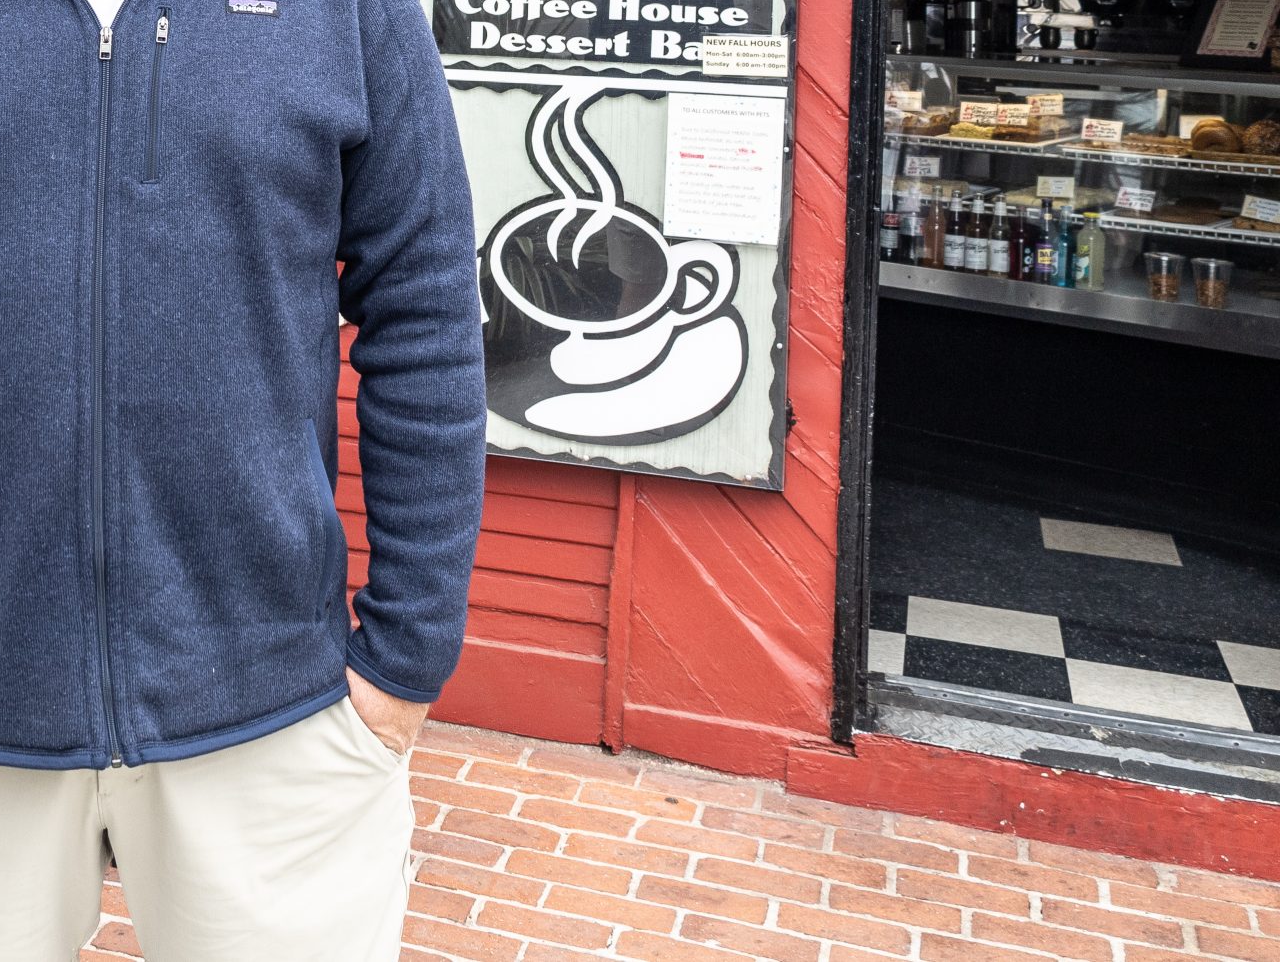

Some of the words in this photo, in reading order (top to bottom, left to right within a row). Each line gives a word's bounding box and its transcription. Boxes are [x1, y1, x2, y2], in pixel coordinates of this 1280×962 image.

[469, 21, 630, 57] Dessert
[650, 29, 703, 60] Ba
[728, 39, 748, 47] FALL
[750, 40, 782, 48] HOURS
[702, 108, 738, 116] CUSTOMERS
